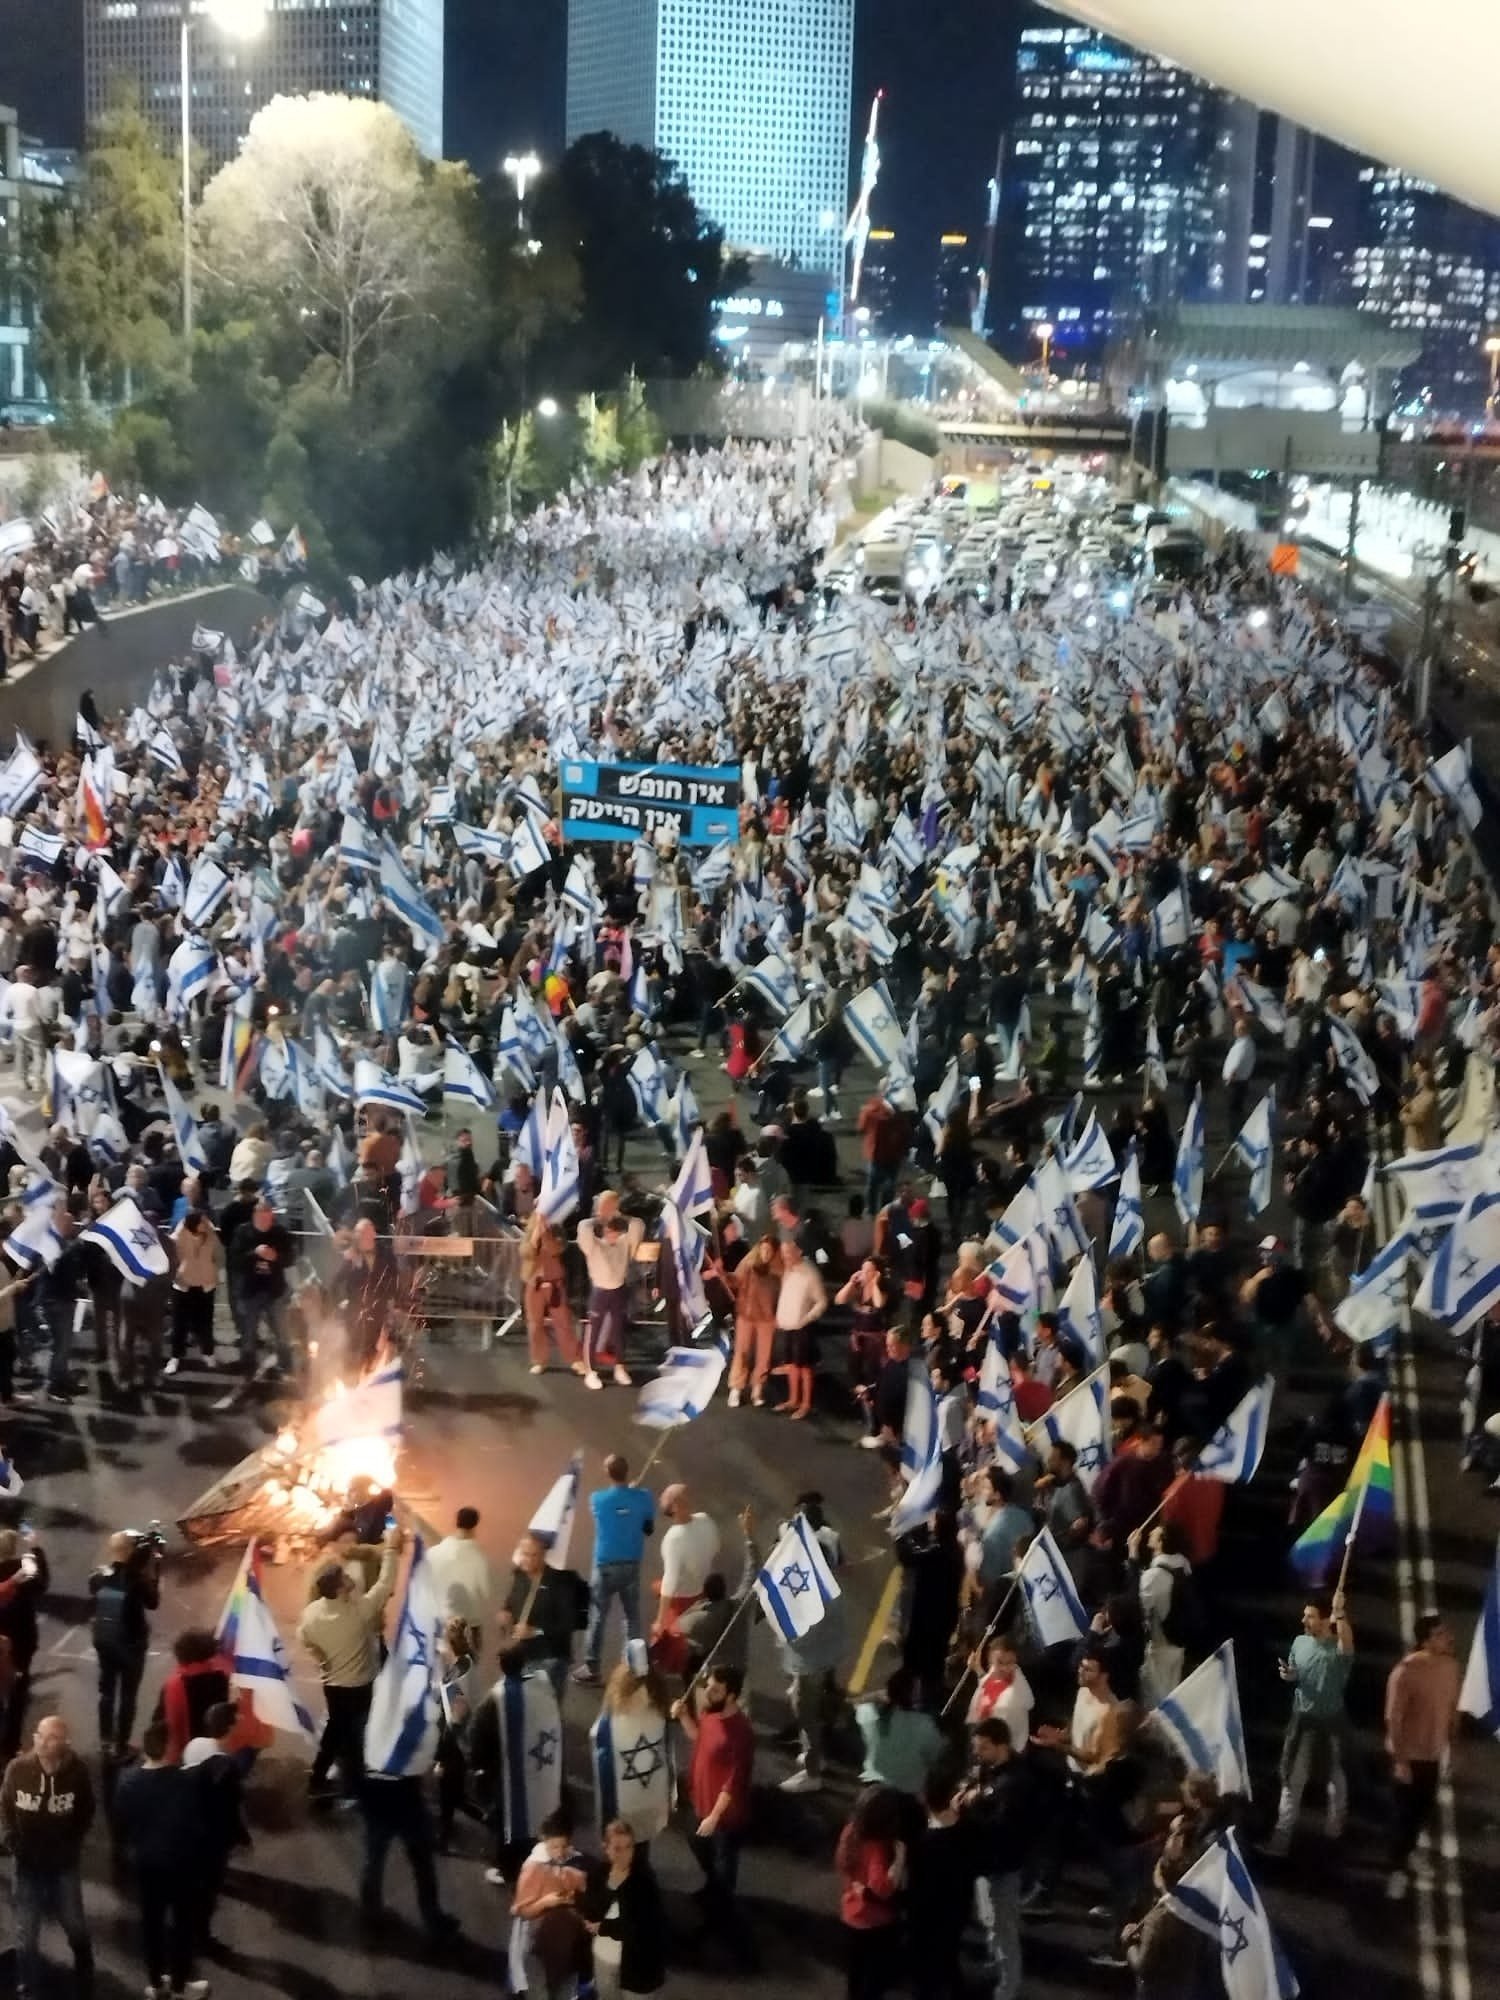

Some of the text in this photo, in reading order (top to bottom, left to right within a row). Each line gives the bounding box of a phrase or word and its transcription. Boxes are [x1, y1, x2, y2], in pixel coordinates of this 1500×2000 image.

[618, 774, 725, 804] אין חופש
[568, 798, 640, 826] הייטק
[645, 809, 681, 831] אין
